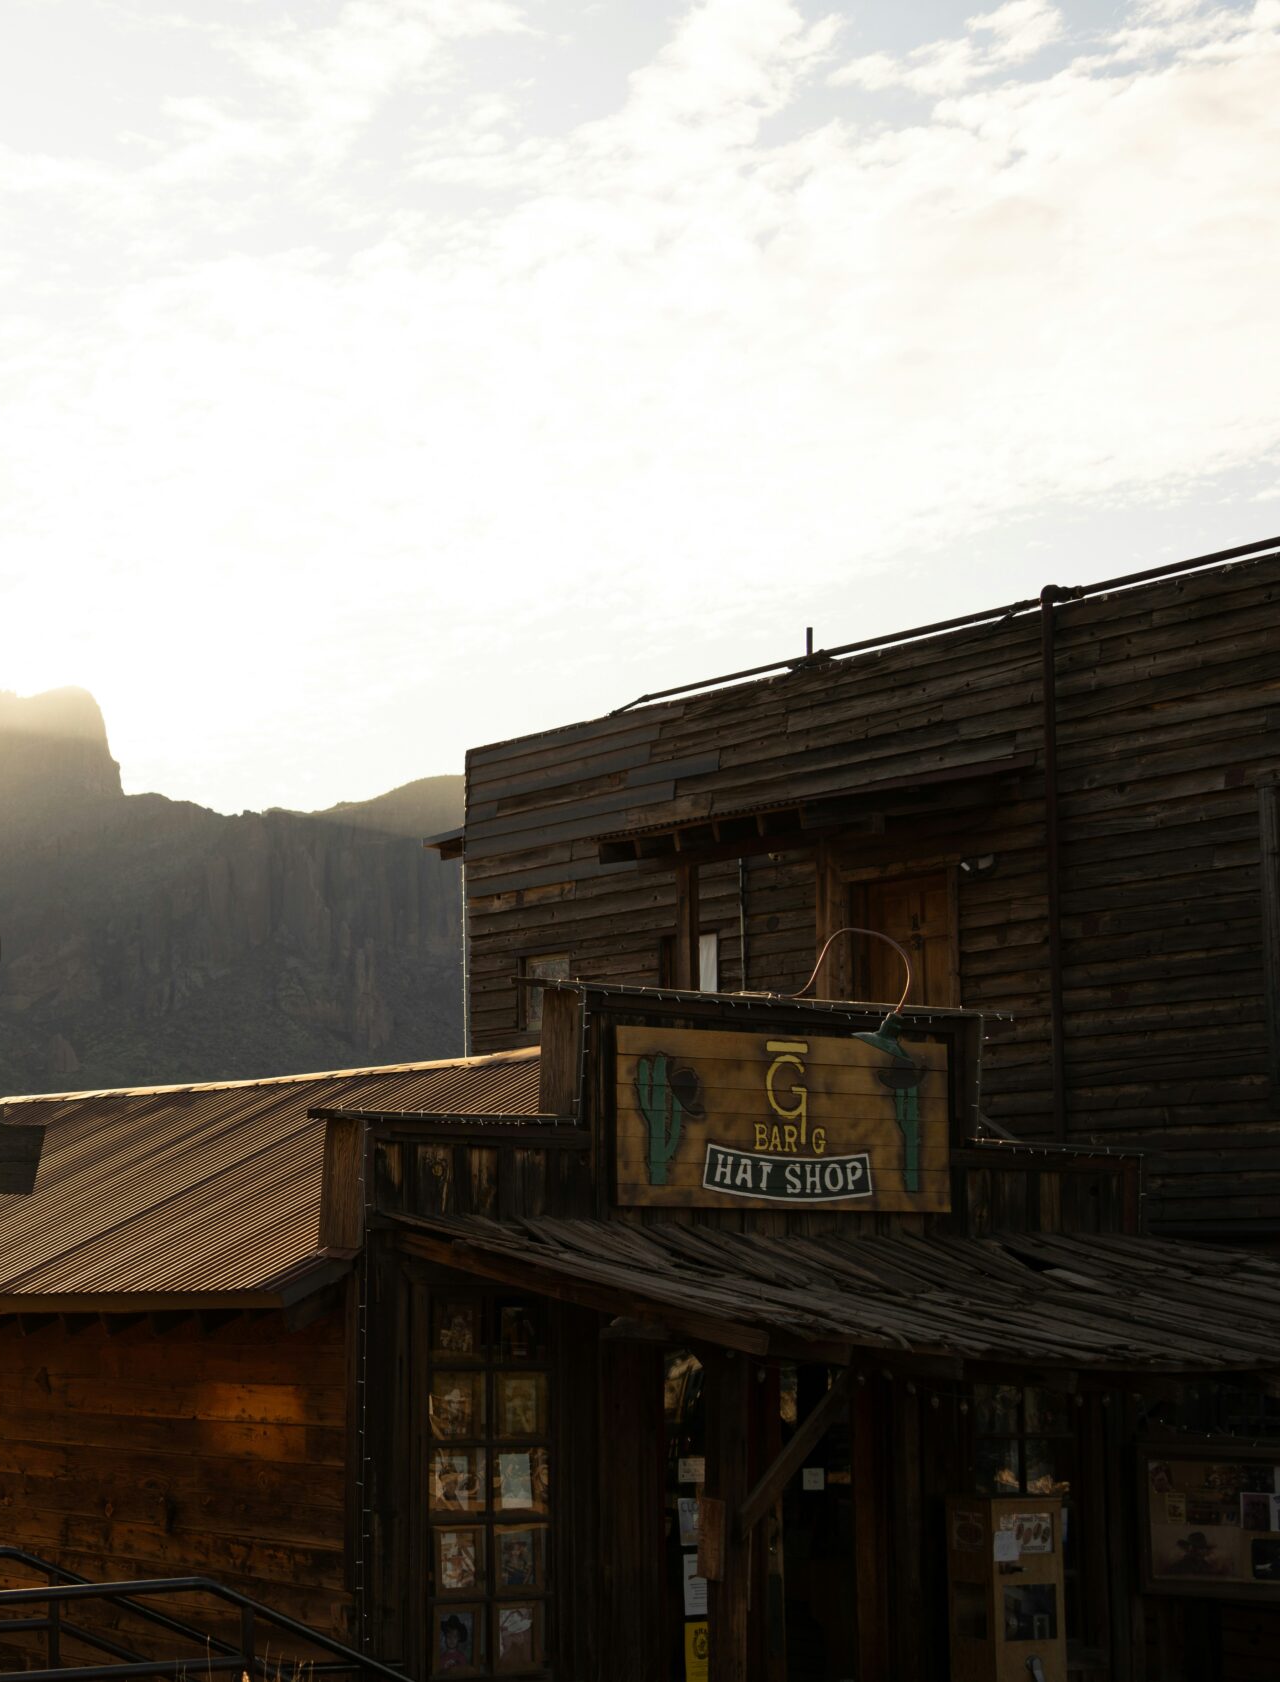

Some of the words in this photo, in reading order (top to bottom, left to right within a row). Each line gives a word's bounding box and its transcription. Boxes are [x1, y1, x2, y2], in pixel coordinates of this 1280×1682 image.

[754, 1122, 798, 1152] BAR
[812, 1127, 827, 1155] G
[715, 1153, 773, 1191] HAT
[785, 1160, 863, 1194] SHOP
